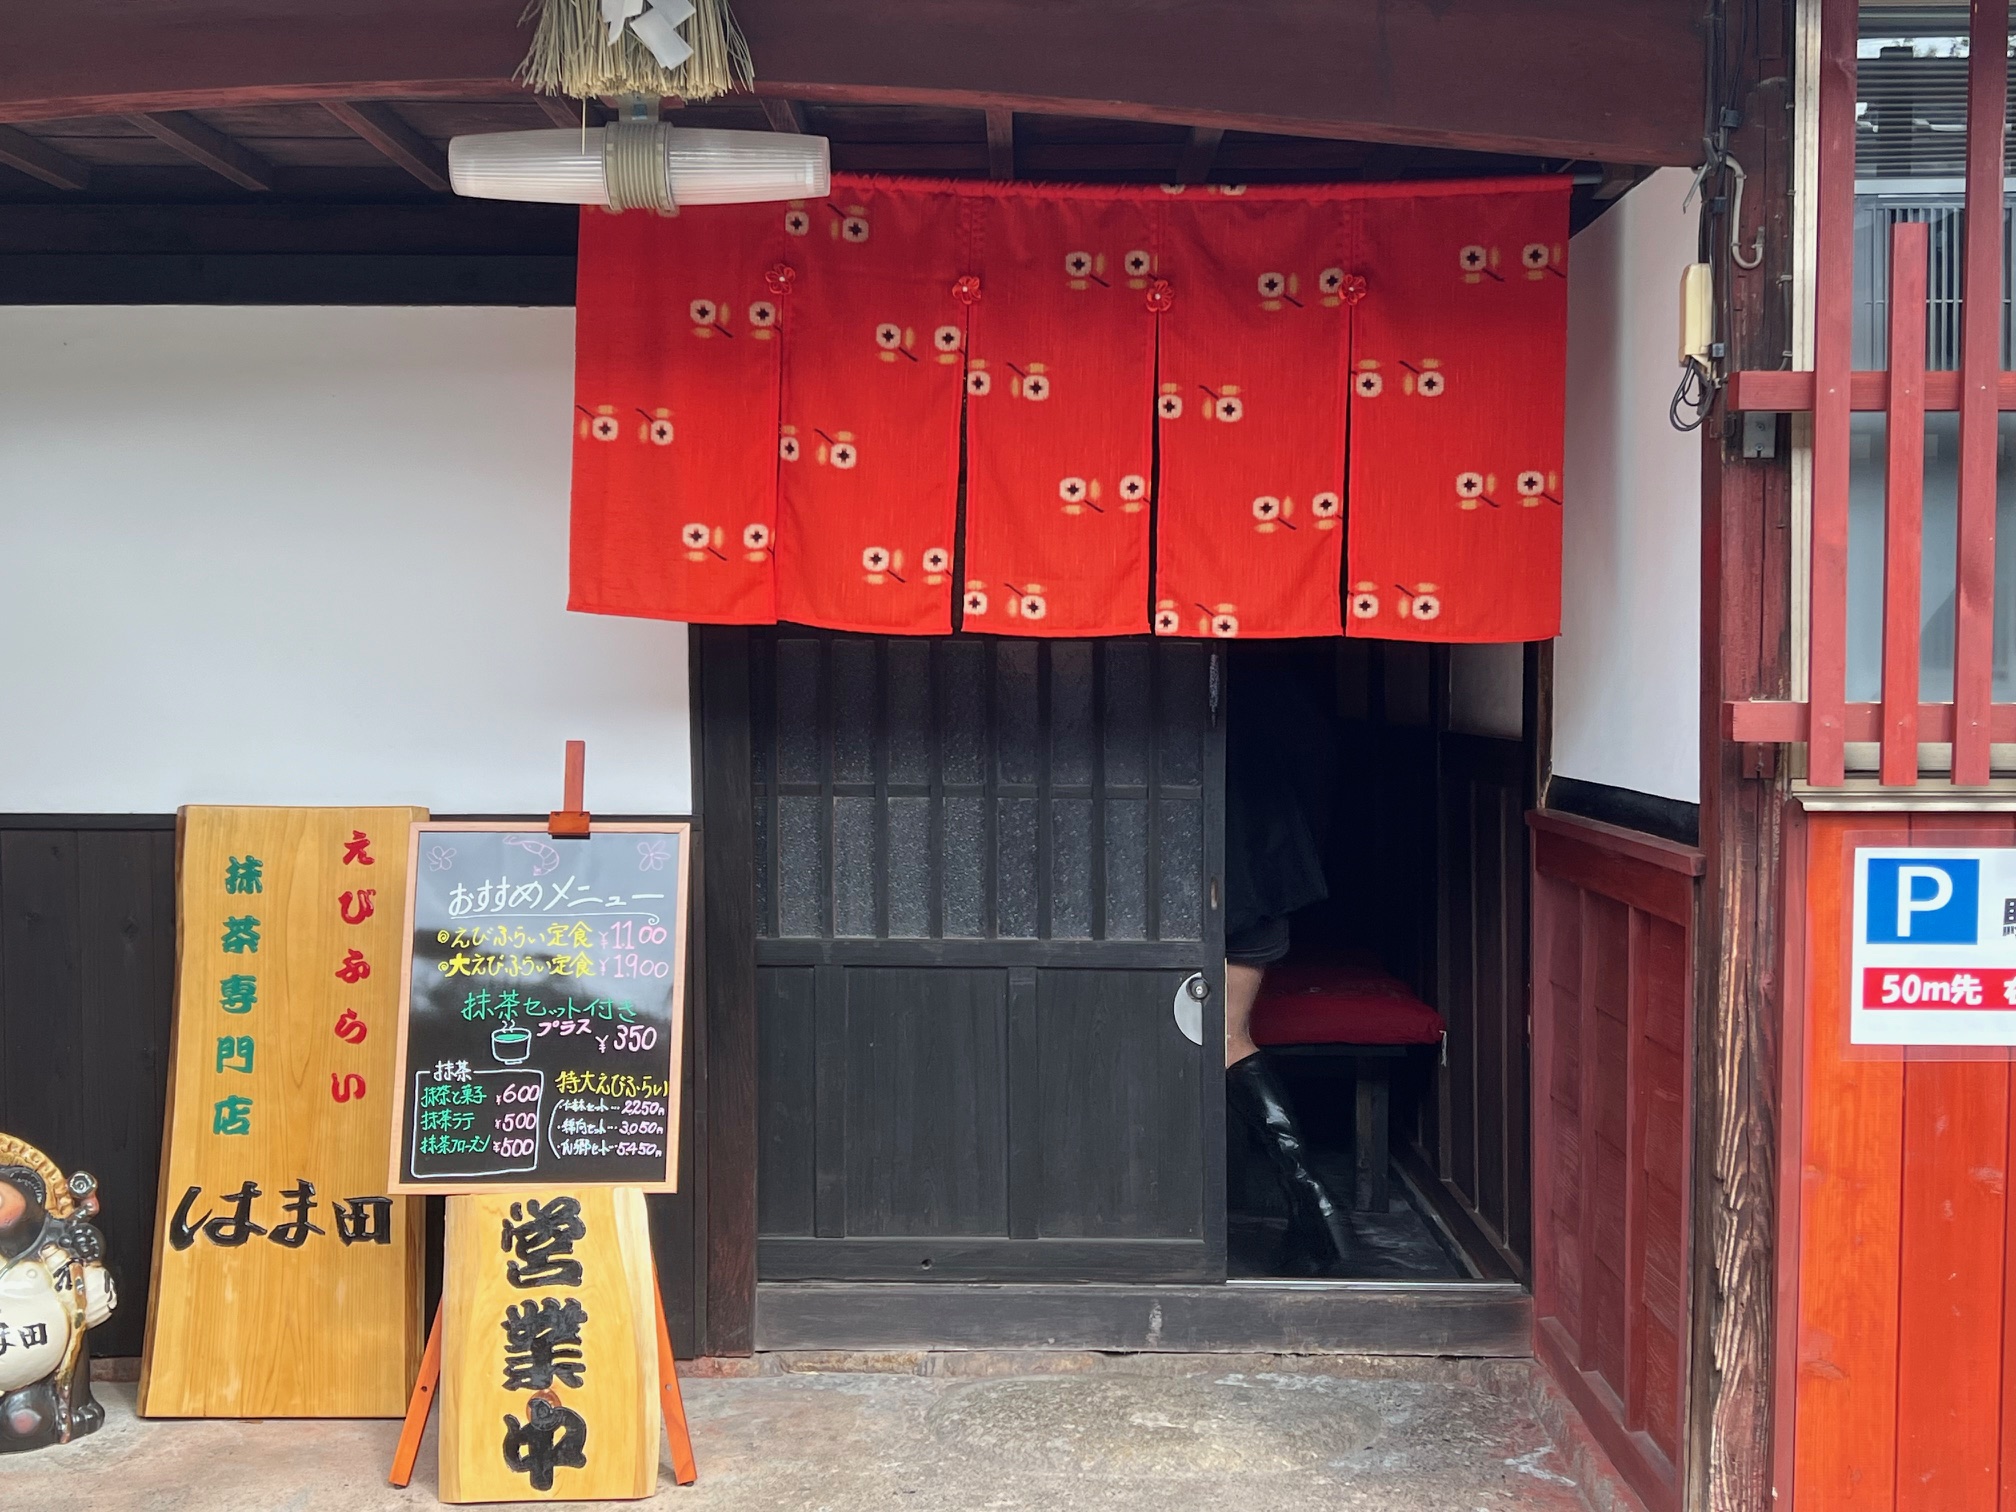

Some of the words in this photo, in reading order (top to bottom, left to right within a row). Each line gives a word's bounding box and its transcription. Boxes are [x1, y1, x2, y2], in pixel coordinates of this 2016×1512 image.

[448, 876, 664, 916] おすすめメニュー
[1897, 866, 1953, 938] P
[451, 921, 594, 948] えびふらい定食
[331, 829, 377, 1103] えびふらい
[445, 951, 596, 978] 大えびふらい定食
[212, 855, 264, 1136] 抹茶専門店
[1882, 973, 1982, 1006] 50m先
[461, 989, 637, 1023] 抹茶セット付き
[537, 1018, 592, 1037] プラス
[595, 1024, 657, 1053] ¥350
[433, 1060, 472, 1083] 抹茶
[555, 1070, 669, 1098] 特大えびふらい
[420, 1083, 487, 1108] 抹茶と菓子
[420, 1108, 475, 1132] 抹茶ラテ
[168, 1179, 393, 1251] はま田
[501, 1196, 588, 1491] 営業中
